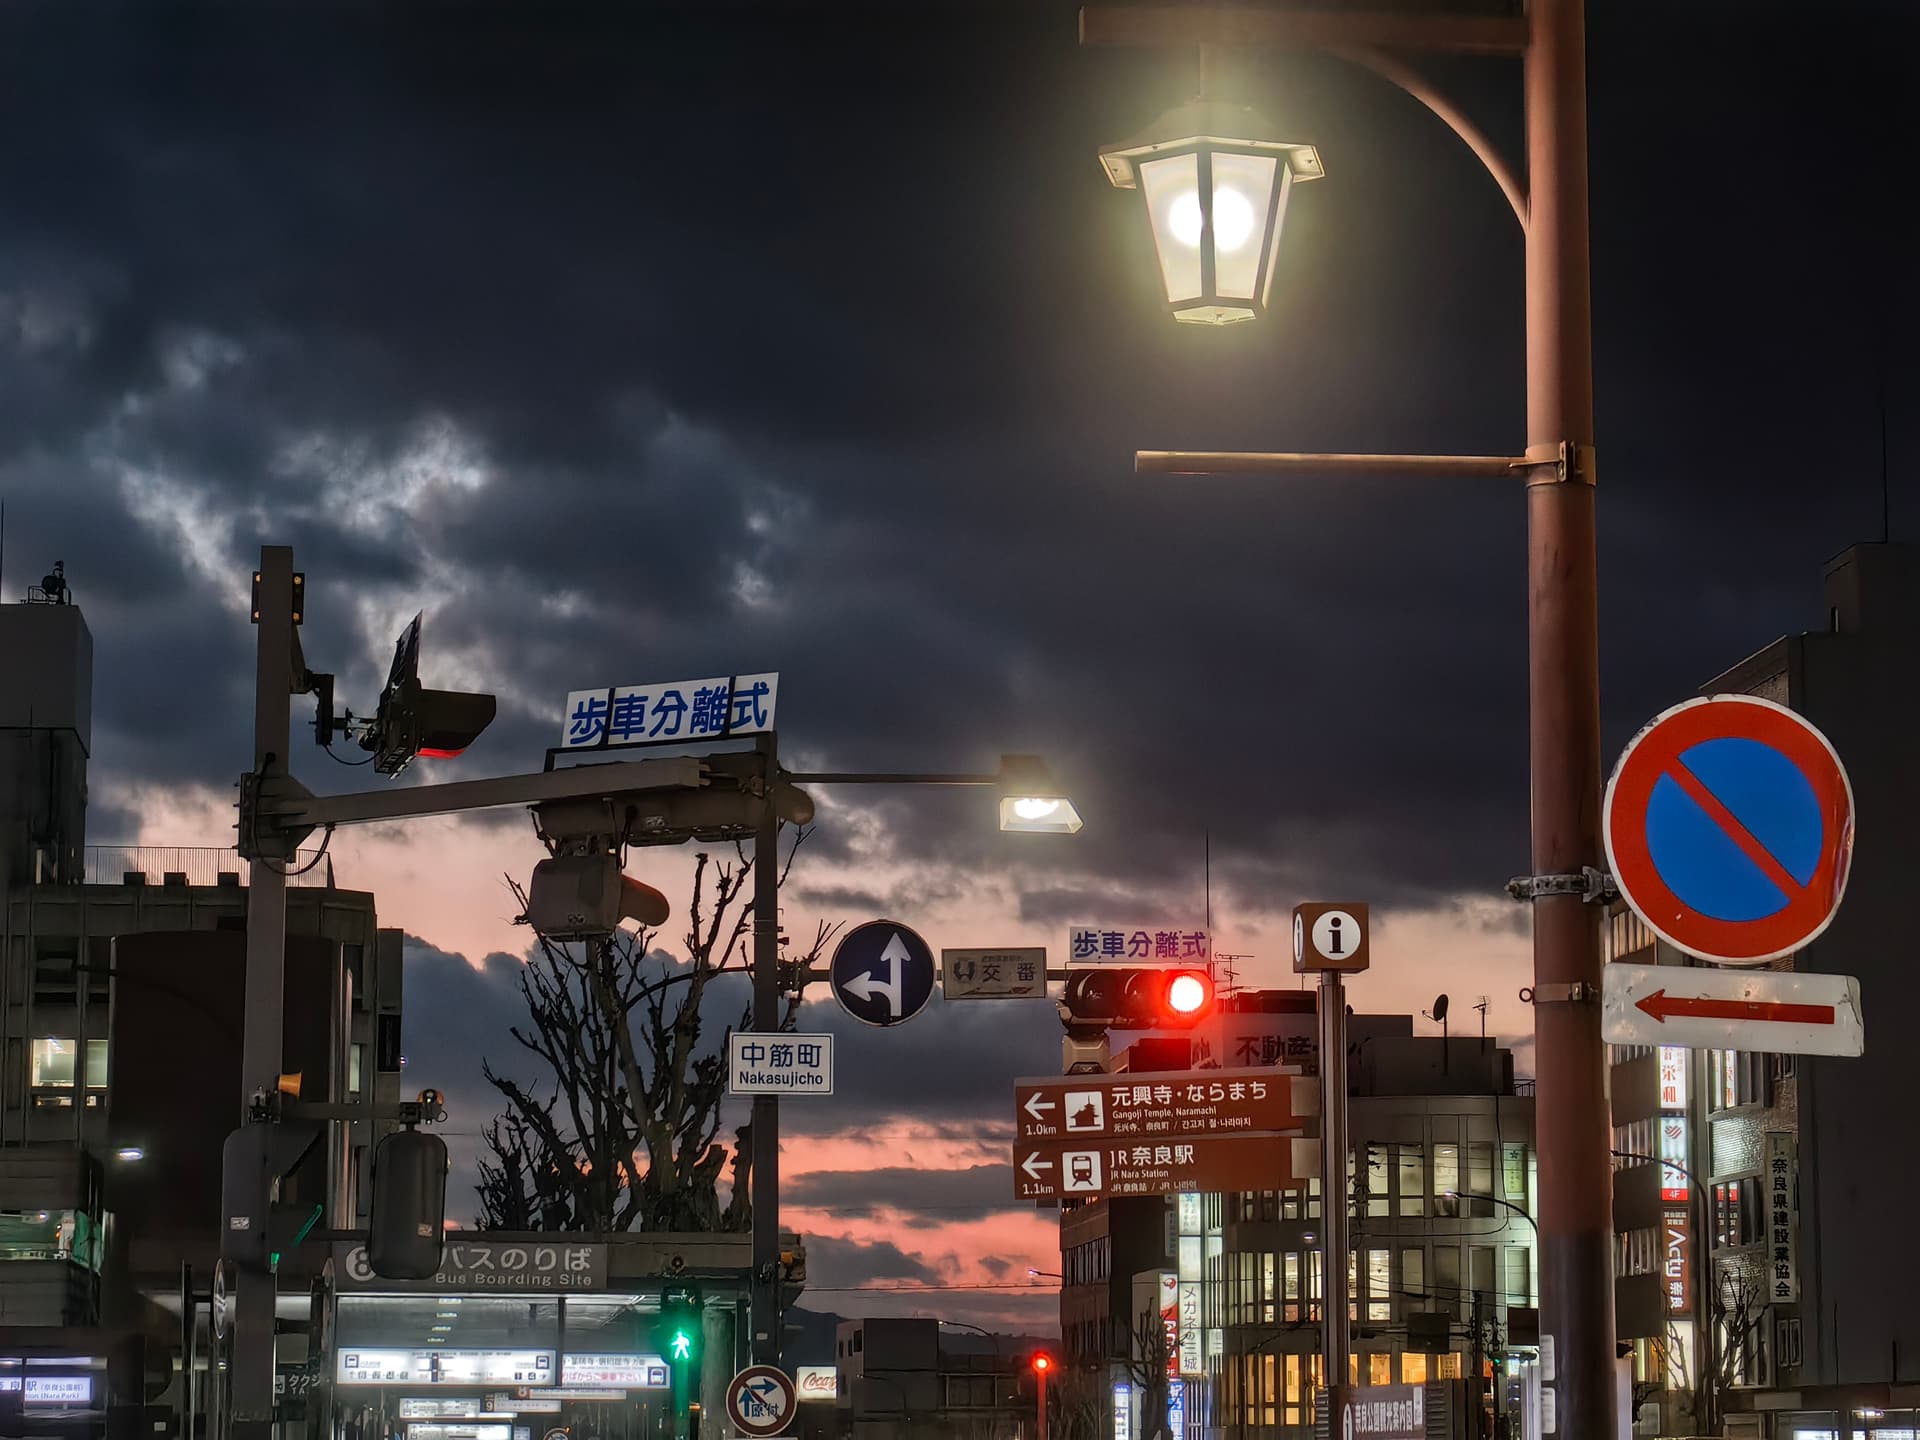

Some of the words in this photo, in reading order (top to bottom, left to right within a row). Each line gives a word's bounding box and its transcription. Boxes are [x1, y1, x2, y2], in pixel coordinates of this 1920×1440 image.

[570, 681, 770, 744] 歩車分離式
[1074, 930, 1205, 958] 歩車分離式
[741, 1042, 822, 1068] 中筋町
[740, 1071, 823, 1087] Nakasujicho
[1111, 1081, 1267, 1106] 元興寺・ならまち
[1112, 1109, 1142, 1120] Gangoji
[1144, 1107, 1174, 1118] Temple,
[1176, 1105, 1217, 1116] Naramachi
[1025, 1124, 1056, 1135] 1.0km
[1111, 1169, 1119, 1180] JR
[1121, 1170, 1140, 1179] Nara
[1141, 1168, 1169, 1178] Station
[1023, 1183, 1054, 1194] 1.1km
[1669, 1190, 1680, 1199] 4F
[1773, 1159, 1790, 1297] 奈良県建設業協会
[440, 1246, 592, 1271] バスのりば
[1666, 1229, 1687, 1277] Acty
[435, 1273, 467, 1285] Bus
[474, 1272, 551, 1286] Boarding
[560, 1272, 592, 1286] Site
[1183, 1287, 1197, 1370] メガネの三城
[752, 1403, 779, 1417] 原付
